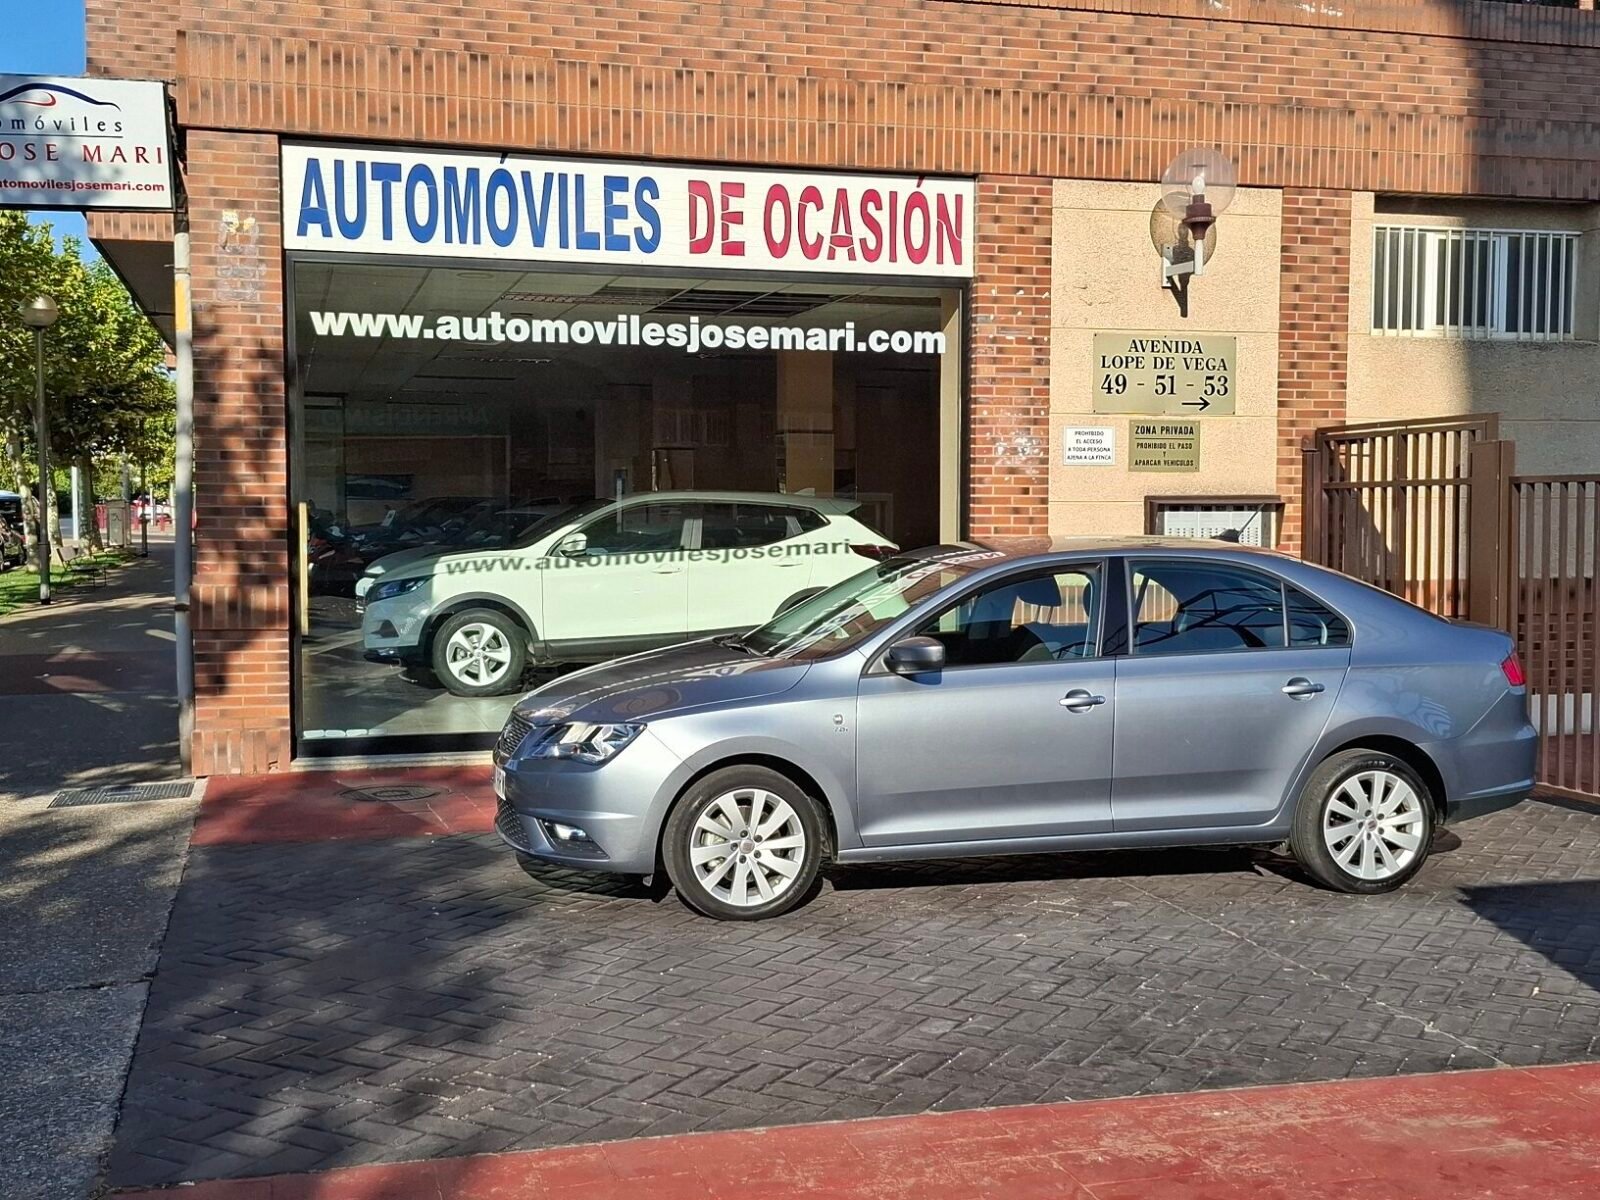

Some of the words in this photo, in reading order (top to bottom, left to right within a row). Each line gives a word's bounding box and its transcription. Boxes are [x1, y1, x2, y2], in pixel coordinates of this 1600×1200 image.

[0, 115, 123, 132] móviles
[82, 144, 163, 164] MARI
[0, 179, 165, 192] tomovilesjosemari.com
[296, 153, 661, 254] AUTOMÓVILES
[688, 179, 746, 257] DE
[763, 176, 964, 266] OCASIÓN
[309, 310, 946, 354] www.automovilesjosemari.com
[1128, 339, 1203, 354] AVENIDA
[1100, 355, 1145, 370] LOPE
[1153, 356, 1176, 370] DE
[1183, 357, 1228, 372] VEGA
[1101, 373, 1127, 395] 49
[1154, 375, 1177, 396] 51
[1203, 375, 1229, 397] 53
[1134, 425, 1157, 435] ZONA
[1160, 425, 1195, 436] PRIVADA
[1136, 442, 1168, 450] PROHIBIDO
[1169, 442, 1176, 450] EL
[1177, 442, 1193, 450] PASO
[1134, 459, 1162, 467] APARCAR
